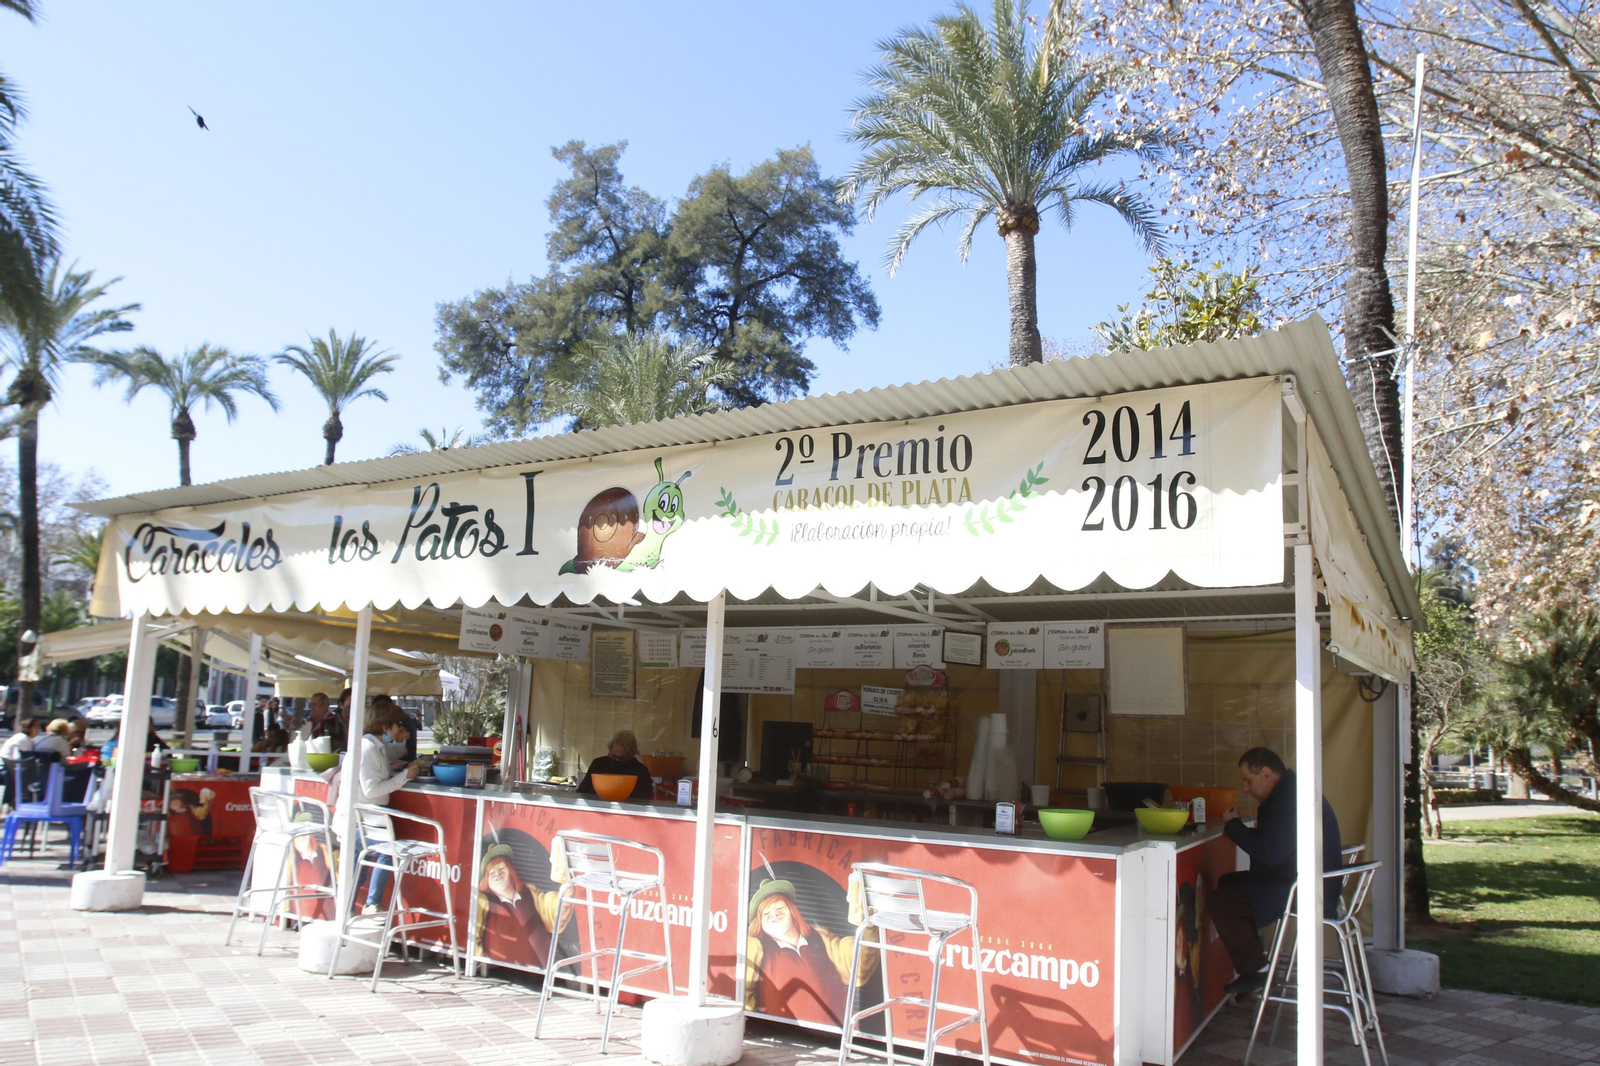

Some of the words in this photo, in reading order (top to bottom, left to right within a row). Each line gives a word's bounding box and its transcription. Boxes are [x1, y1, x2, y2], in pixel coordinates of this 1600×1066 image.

[775, 434, 814, 486] 2º
[829, 424, 973, 481] Premio
[1082, 400, 1196, 465] 2014
[773, 484, 859, 513] CARACOL
[867, 481, 893, 509] DE
[901, 476, 973, 506] PLATA
[1081, 471, 1197, 531] 2016
[125, 520, 282, 583] Caracoles
[328, 515, 382, 565] los
[391, 482, 509, 564] Patos
[889, 516, 952, 545] propia!
[225, 802, 253, 812] Cruzc
[758, 828, 854, 871] FABRICA
[928, 936, 1099, 990] Cruzcampo
